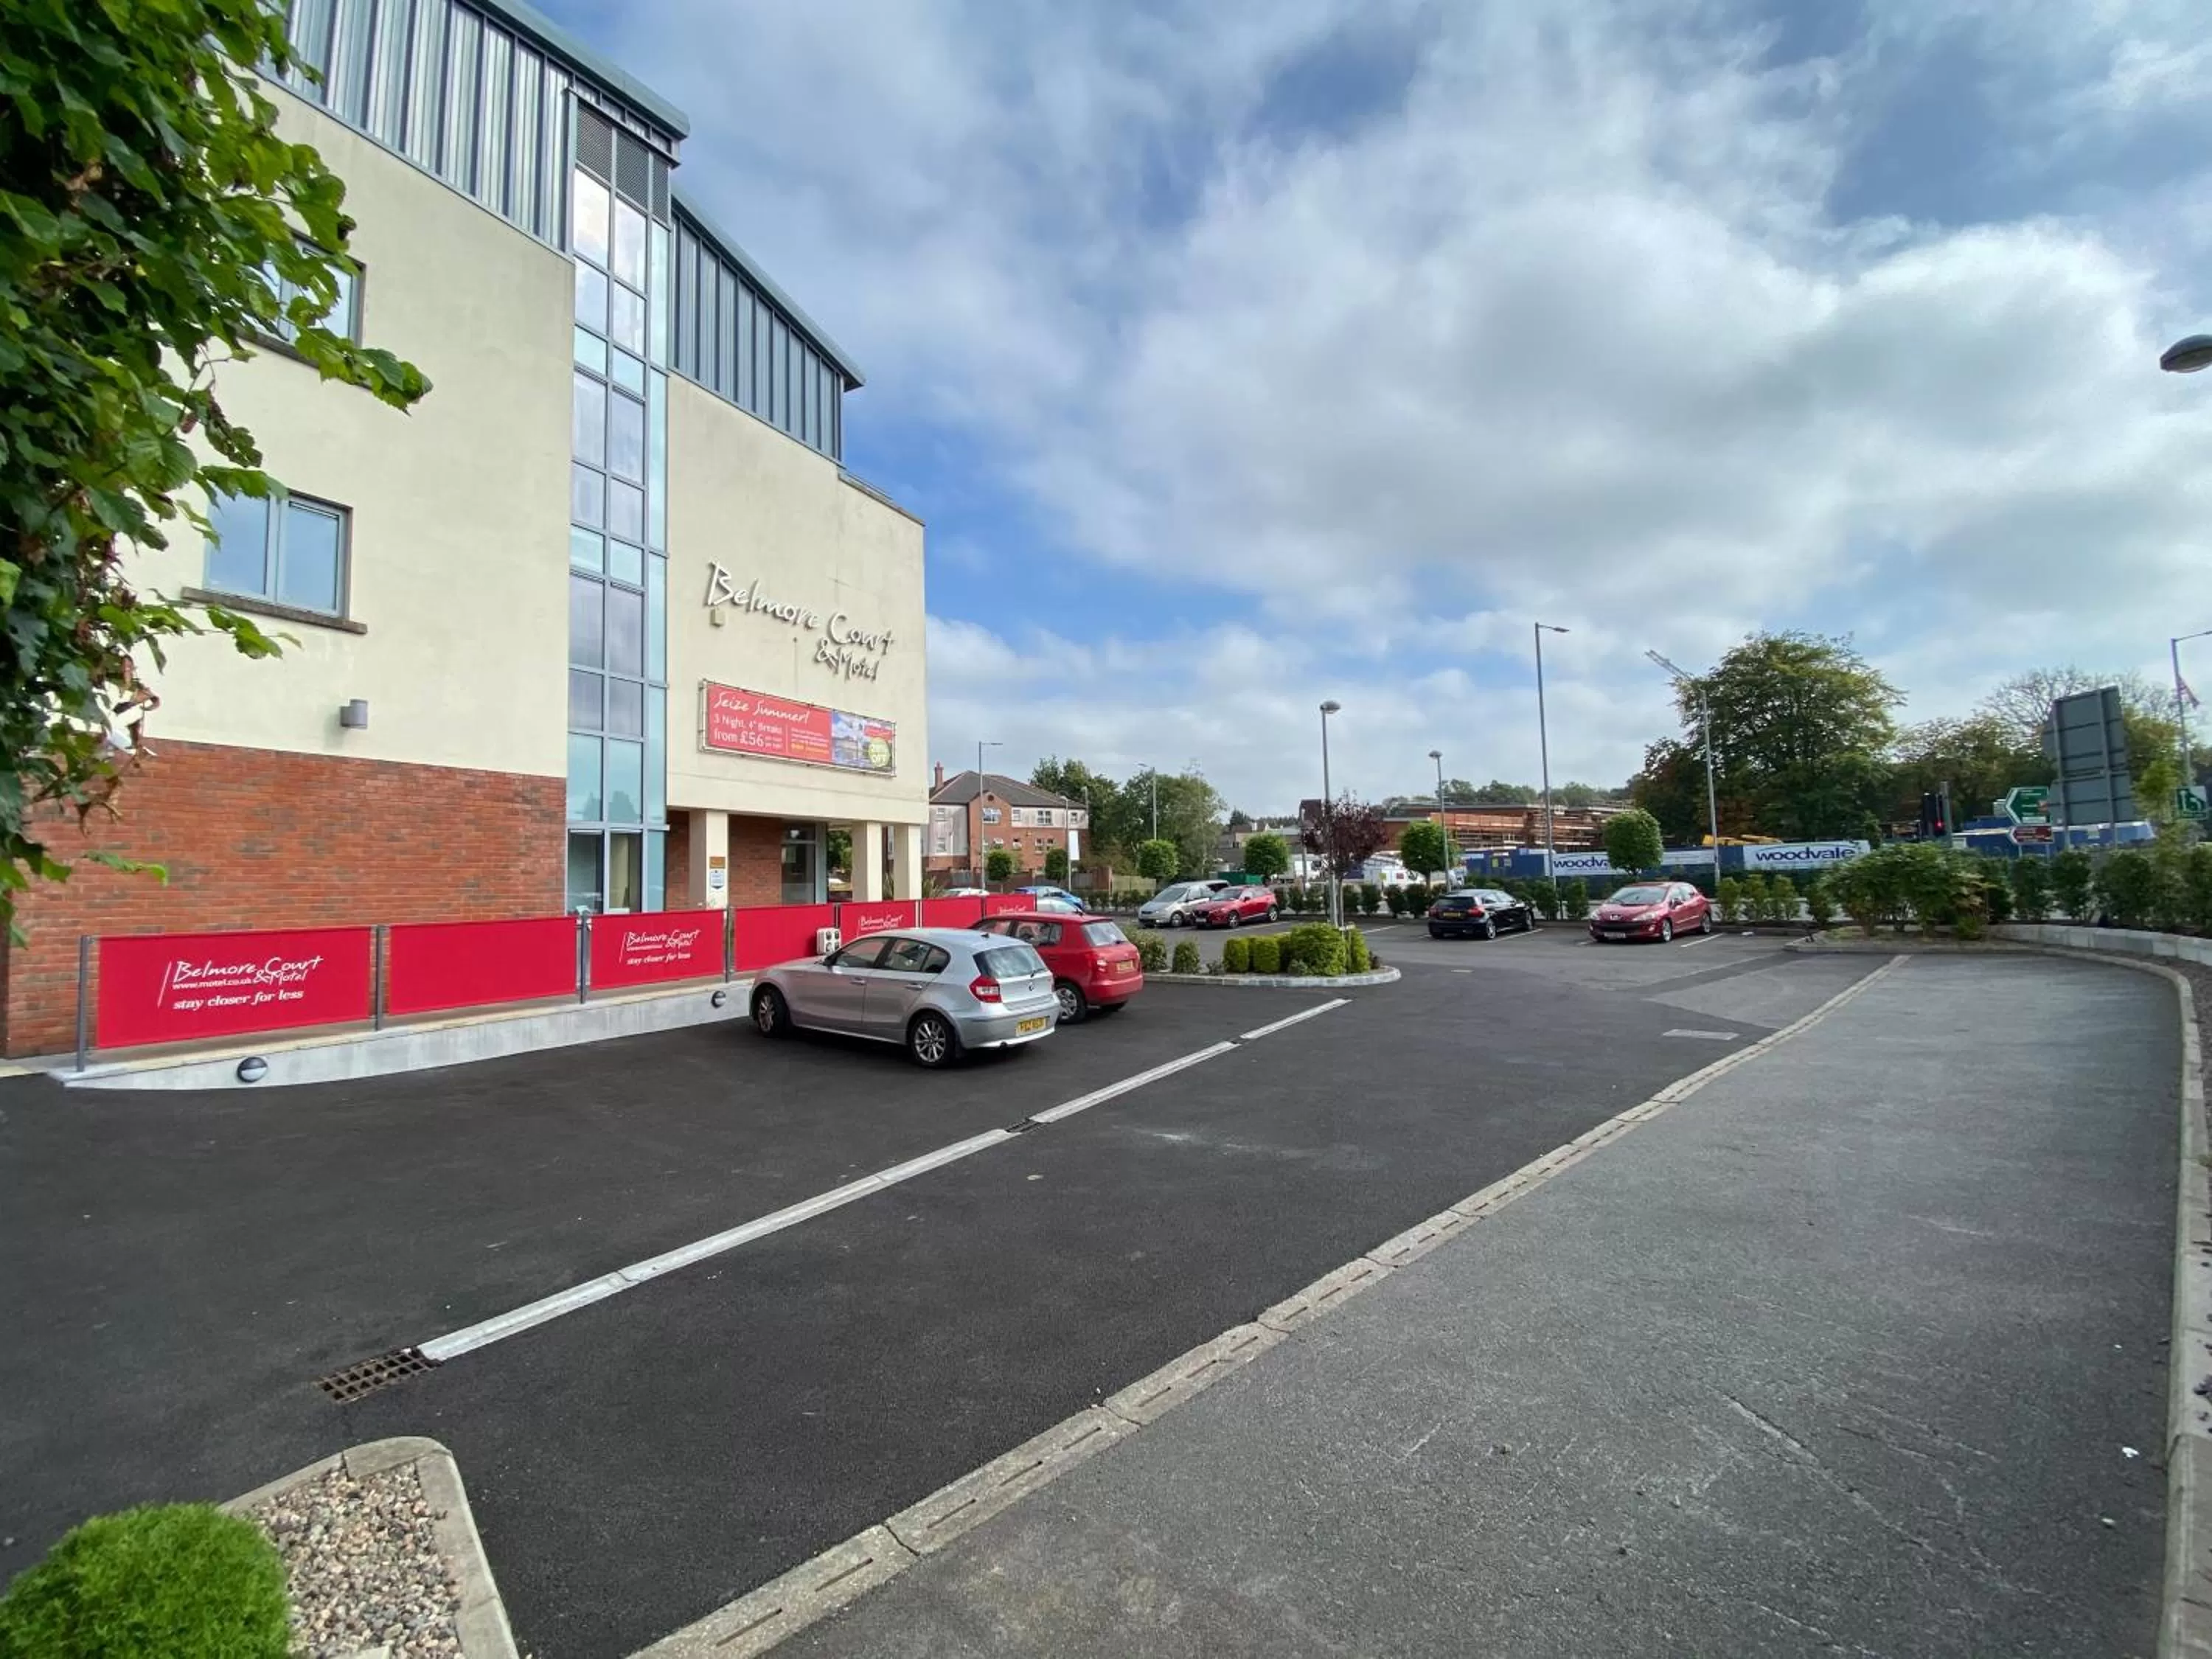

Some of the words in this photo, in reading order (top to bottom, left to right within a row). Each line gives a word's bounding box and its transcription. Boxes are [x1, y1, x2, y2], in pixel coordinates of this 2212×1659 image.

[705, 560, 821, 630] Belmore
[827, 613, 894, 655] Court
[835, 647, 880, 682] Motel
[712, 690, 750, 712] Seize
[714, 727, 738, 743] from
[740, 731, 765, 748] £56
[1554, 857, 1607, 868] woodva
[1756, 846, 1856, 861] woodvale
[626, 931, 668, 947] Belmore
[670, 929, 701, 939] Court
[172, 978, 252, 990] www.motel.co.uk
[267, 969, 308, 986] Motel
[173, 960, 257, 983] Belmore
[265, 956, 324, 973] Court
[173, 998, 204, 1011] stay
[207, 995, 251, 1007] closer
[251, 991, 275, 1006] for
[278, 989, 305, 1001] less
